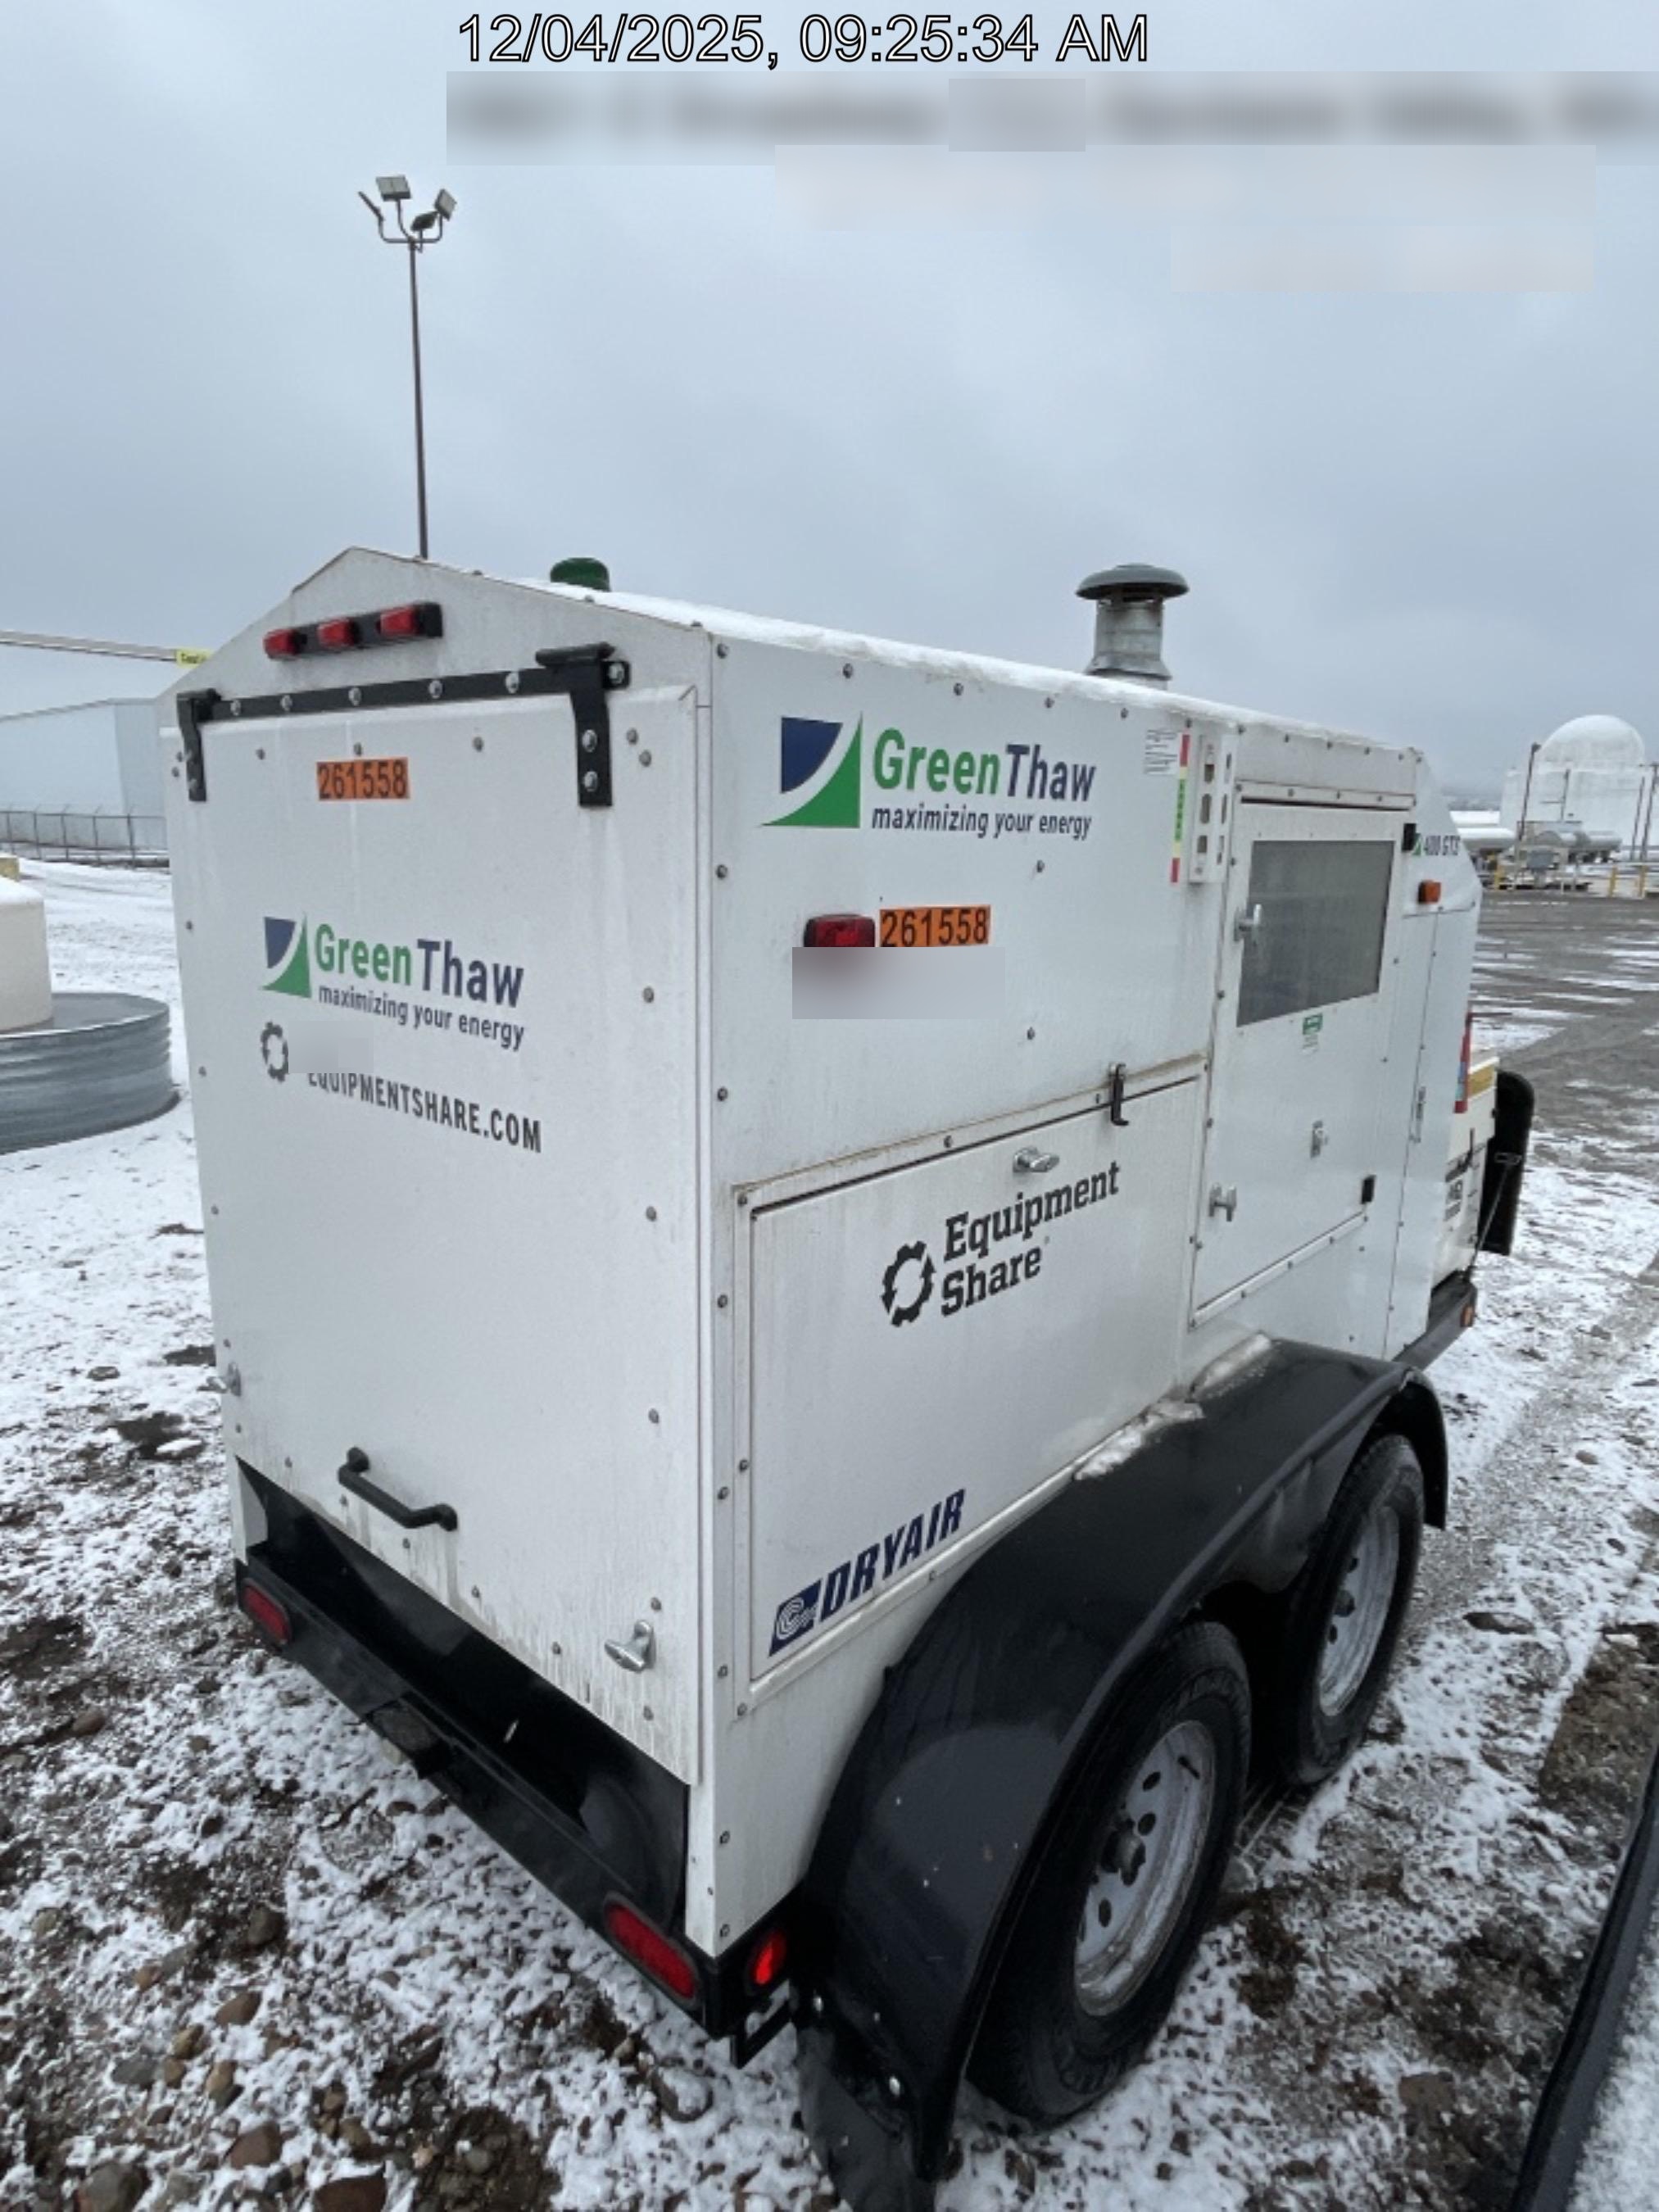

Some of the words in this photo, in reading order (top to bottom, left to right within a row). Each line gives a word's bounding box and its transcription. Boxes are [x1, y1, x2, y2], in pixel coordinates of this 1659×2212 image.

[317, 759, 406, 800] 261558
[871, 802, 989, 839] maximizing
[992, 812, 1035, 839] your
[1038, 814, 1092, 841] energy
[881, 907, 988, 947] 261558
[318, 985, 408, 1026] maximizing
[413, 1004, 451, 1029] your
[458, 1013, 524, 1051] energy
[944, 1160, 1120, 1263] Equipment
[941, 1246, 1041, 1317] Share
[820, 1489, 965, 1622] DRYAIR
